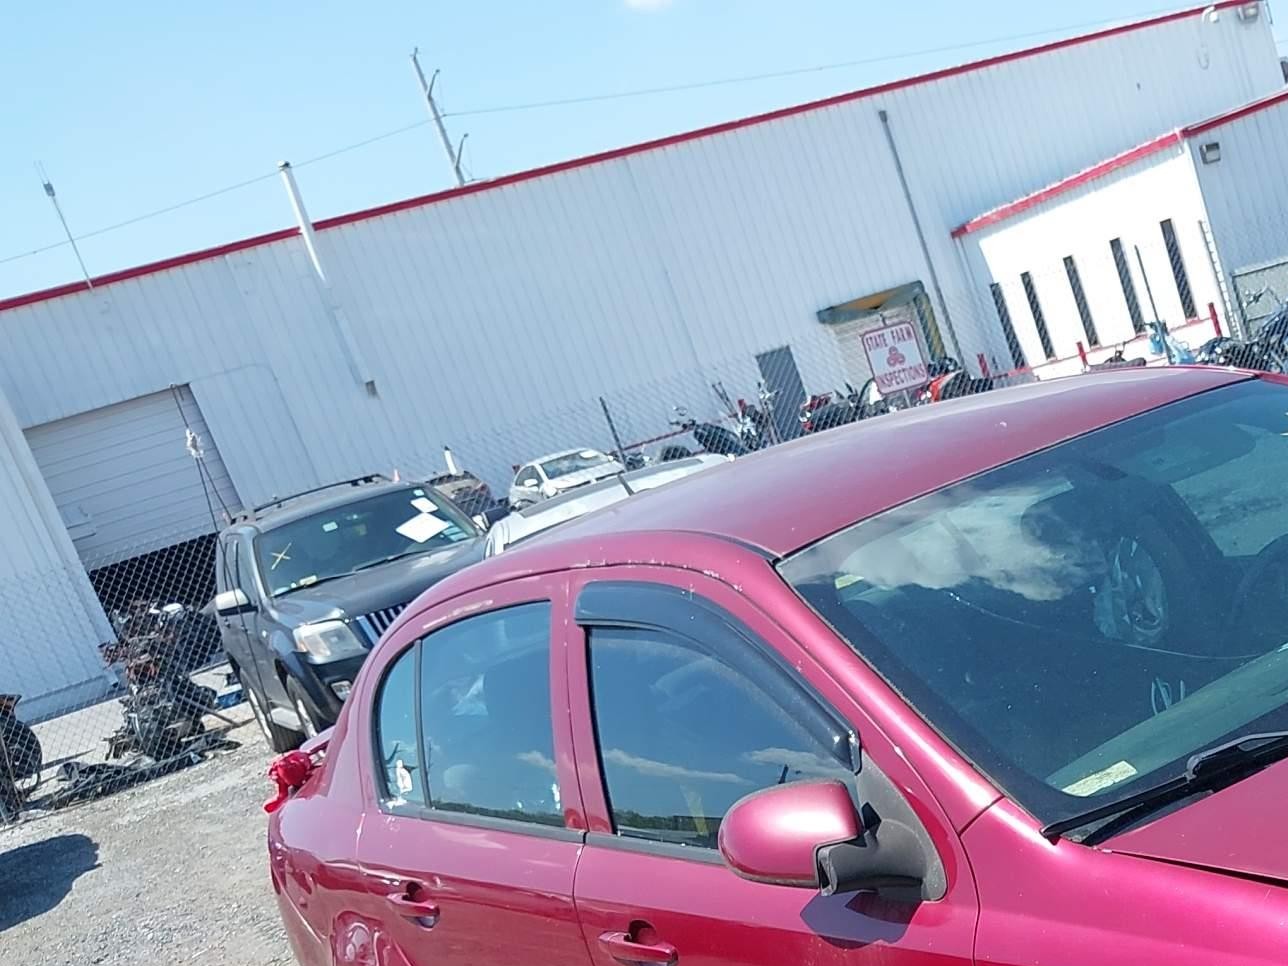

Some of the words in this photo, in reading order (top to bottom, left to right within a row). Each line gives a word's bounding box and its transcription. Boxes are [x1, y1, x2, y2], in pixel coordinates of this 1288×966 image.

[865, 333, 888, 352] STATE
[891, 327, 913, 345] FARM
[876, 364, 926, 387] INSPECTIONS
